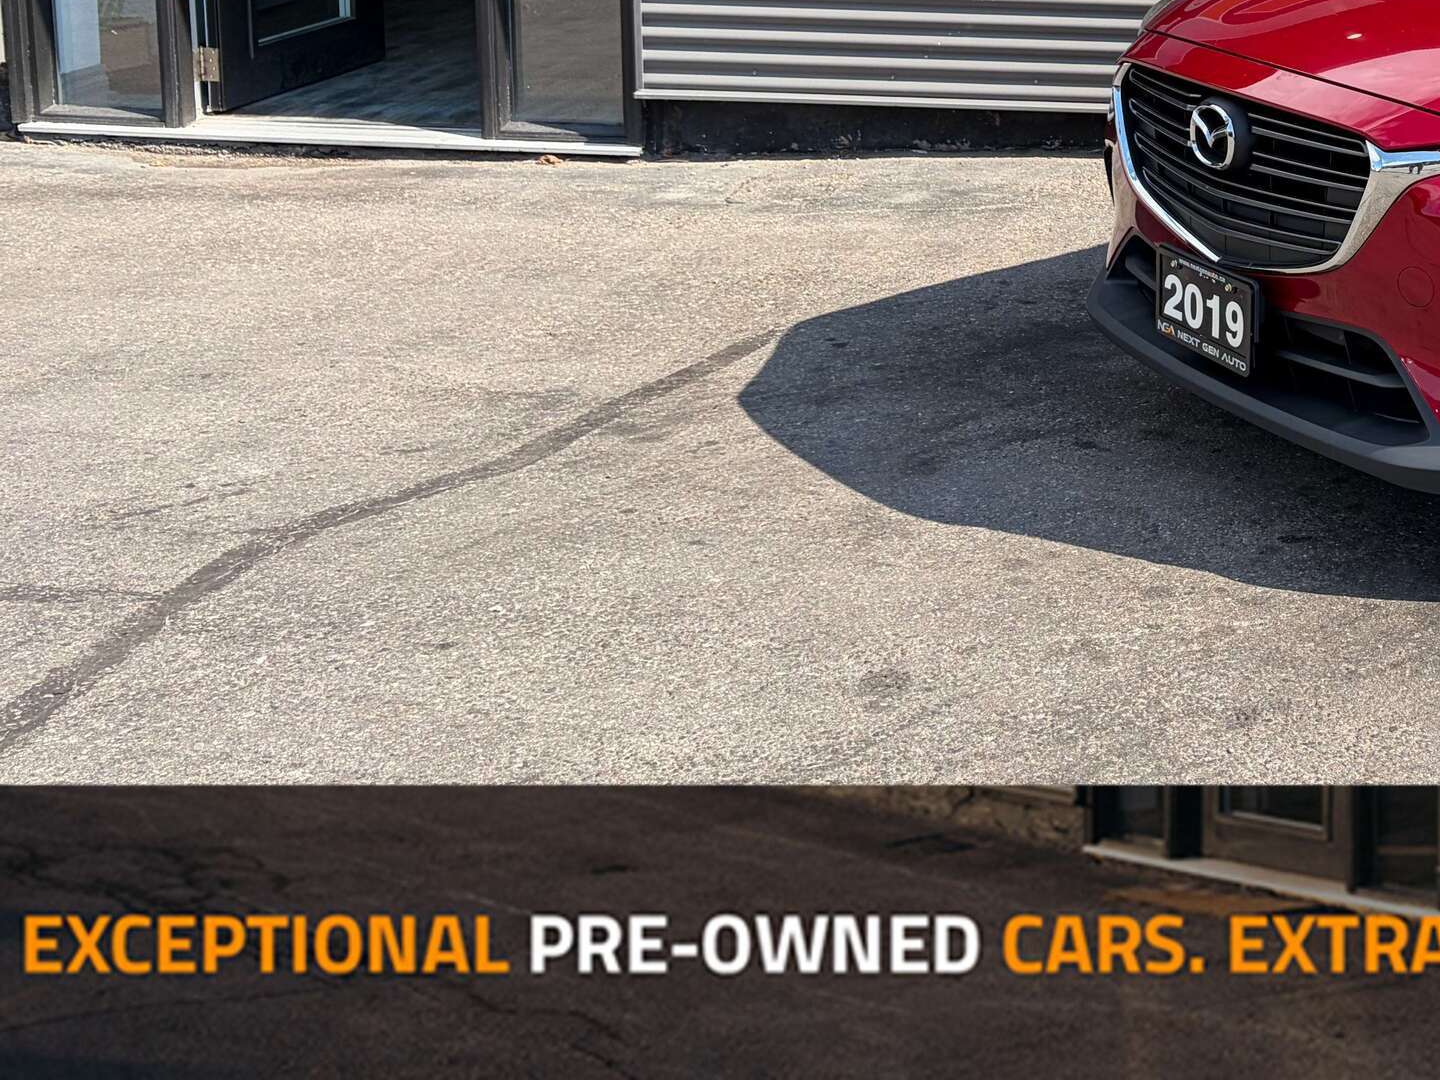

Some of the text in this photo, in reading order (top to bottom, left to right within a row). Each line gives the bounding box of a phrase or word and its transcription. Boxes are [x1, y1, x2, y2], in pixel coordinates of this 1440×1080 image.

[1163, 274, 1244, 348] 2019
[1157, 319, 1247, 372] NGA NEXT GEN AUTO
